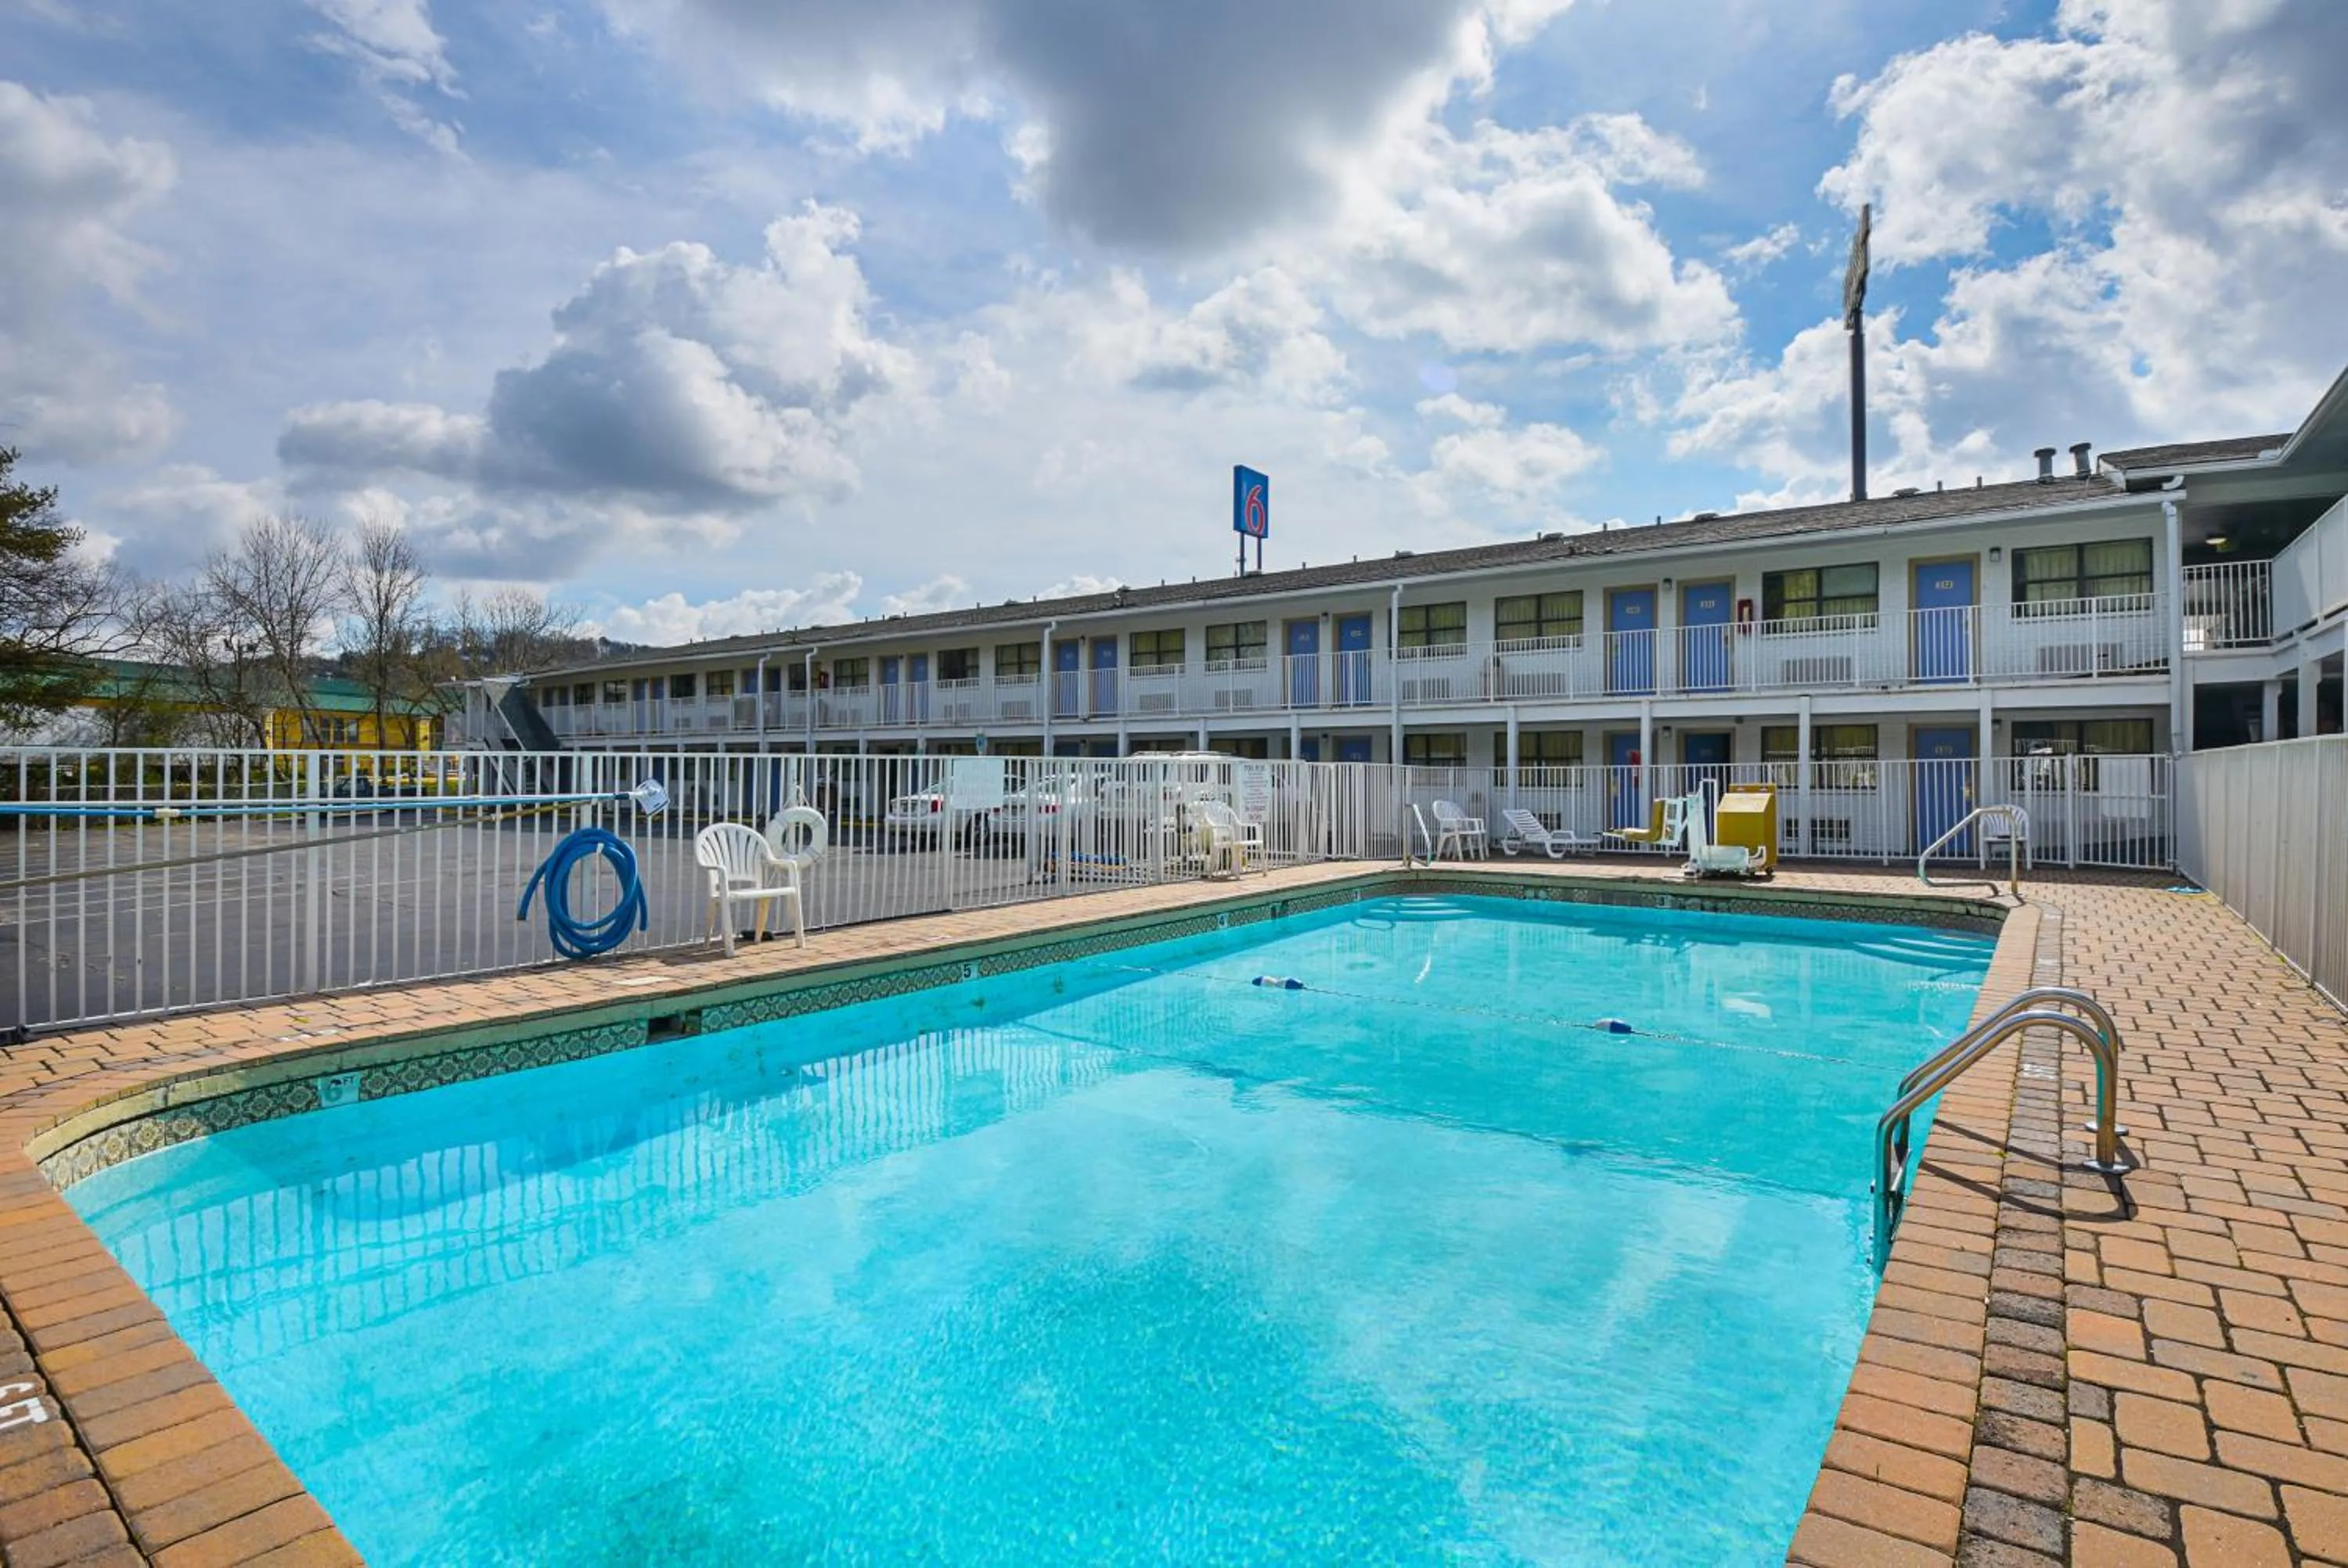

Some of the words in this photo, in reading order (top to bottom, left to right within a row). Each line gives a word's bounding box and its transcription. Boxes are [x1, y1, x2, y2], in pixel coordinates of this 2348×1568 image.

[1245, 484, 1265, 535] 6
[963, 964, 971, 979] 5
[325, 1078, 343, 1102] 6
[344, 1076, 355, 1085] FT
